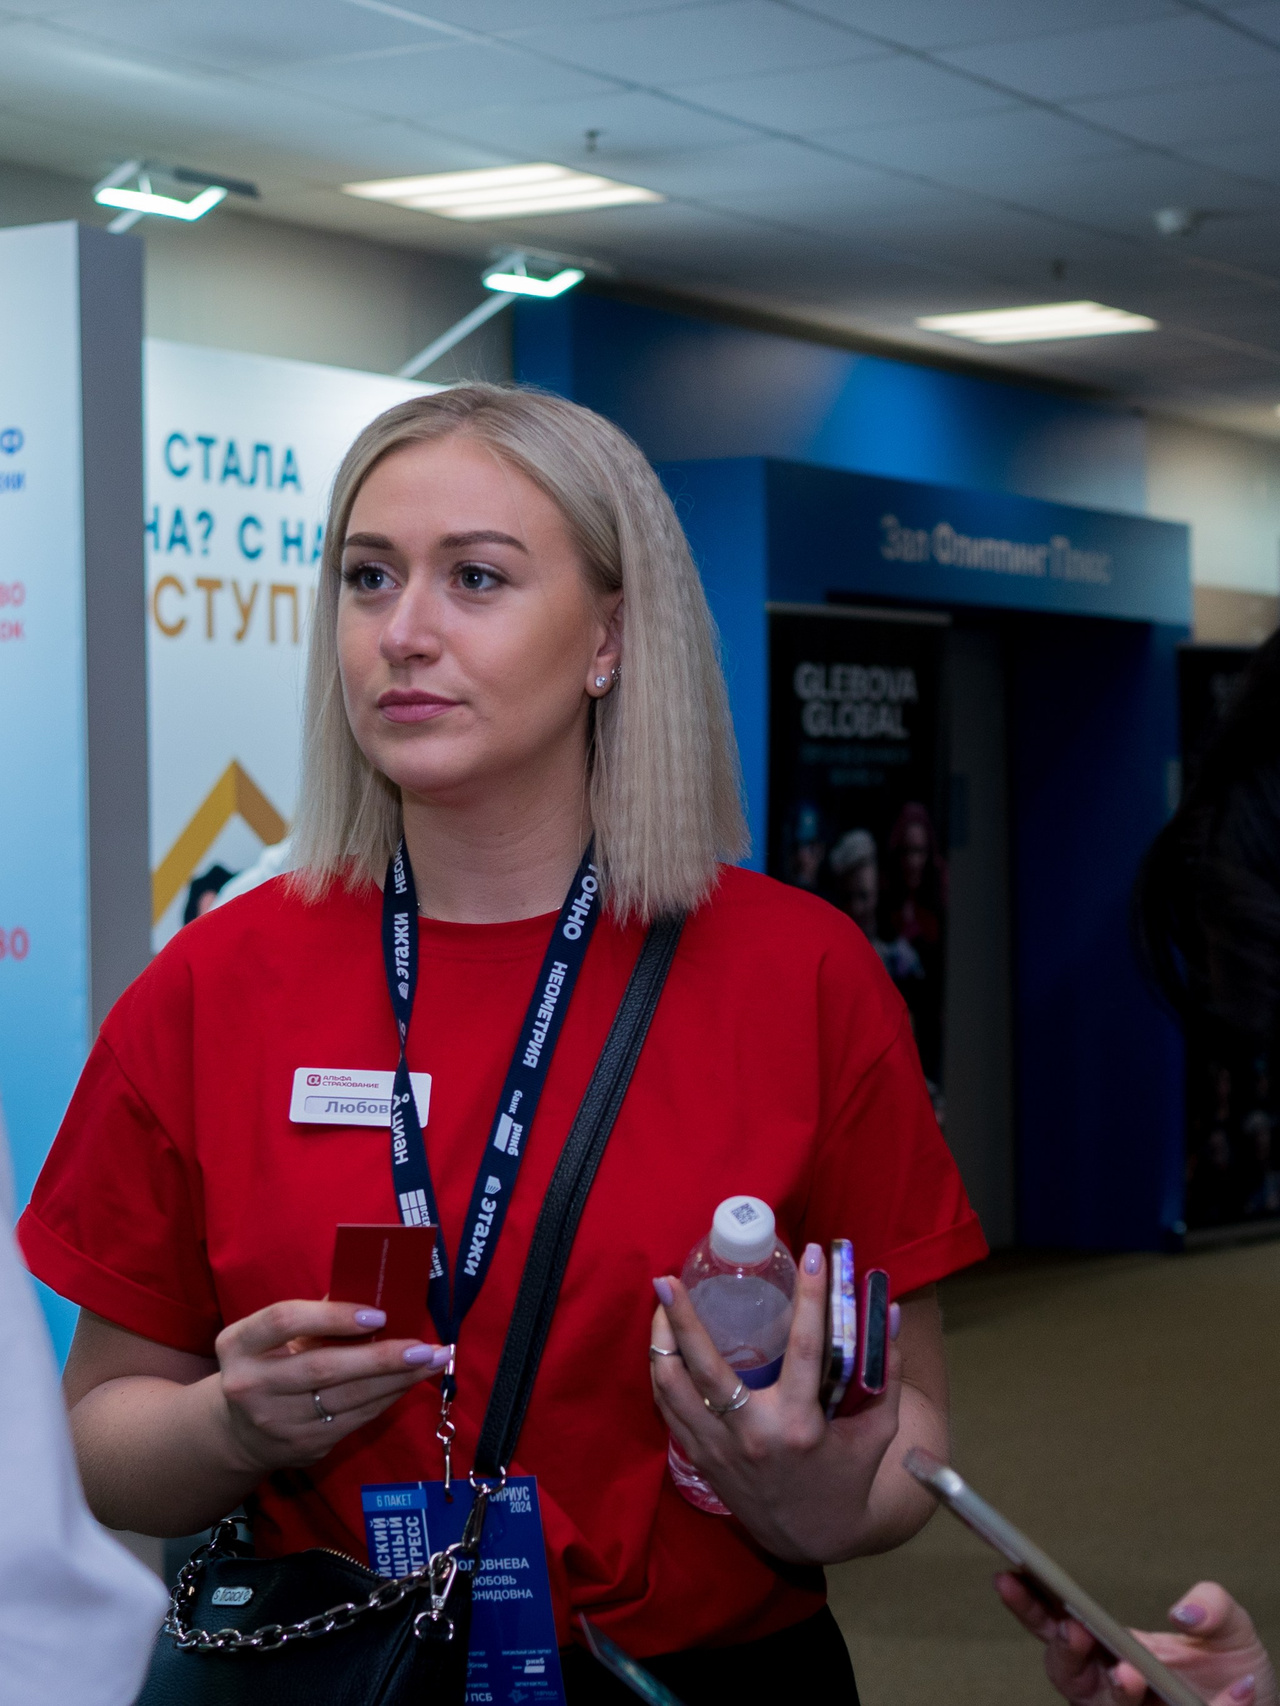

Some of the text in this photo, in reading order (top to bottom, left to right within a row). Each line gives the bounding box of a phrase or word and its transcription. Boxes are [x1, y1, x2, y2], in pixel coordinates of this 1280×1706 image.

[164, 432, 302, 492] СТАЛА
[237, 515, 264, 561] С
[152, 574, 317, 644] СТУП
[793, 661, 918, 704] GLEBOVA
[801, 701, 910, 739] GLOBAL
[522, 960, 569, 1069] НЕОМЕТРИЯ
[322, 1081, 380, 1089] СТРАХОВАНИЕ
[508, 1089, 523, 1115] банк
[325, 1101, 389, 1115] Любов
[507, 1122, 523, 1157] рнкб
[376, 1493, 412, 1507] 6 ПАКЕТ
[510, 1501, 532, 1513] 2024
[470, 1692, 493, 1702] ПСБ
